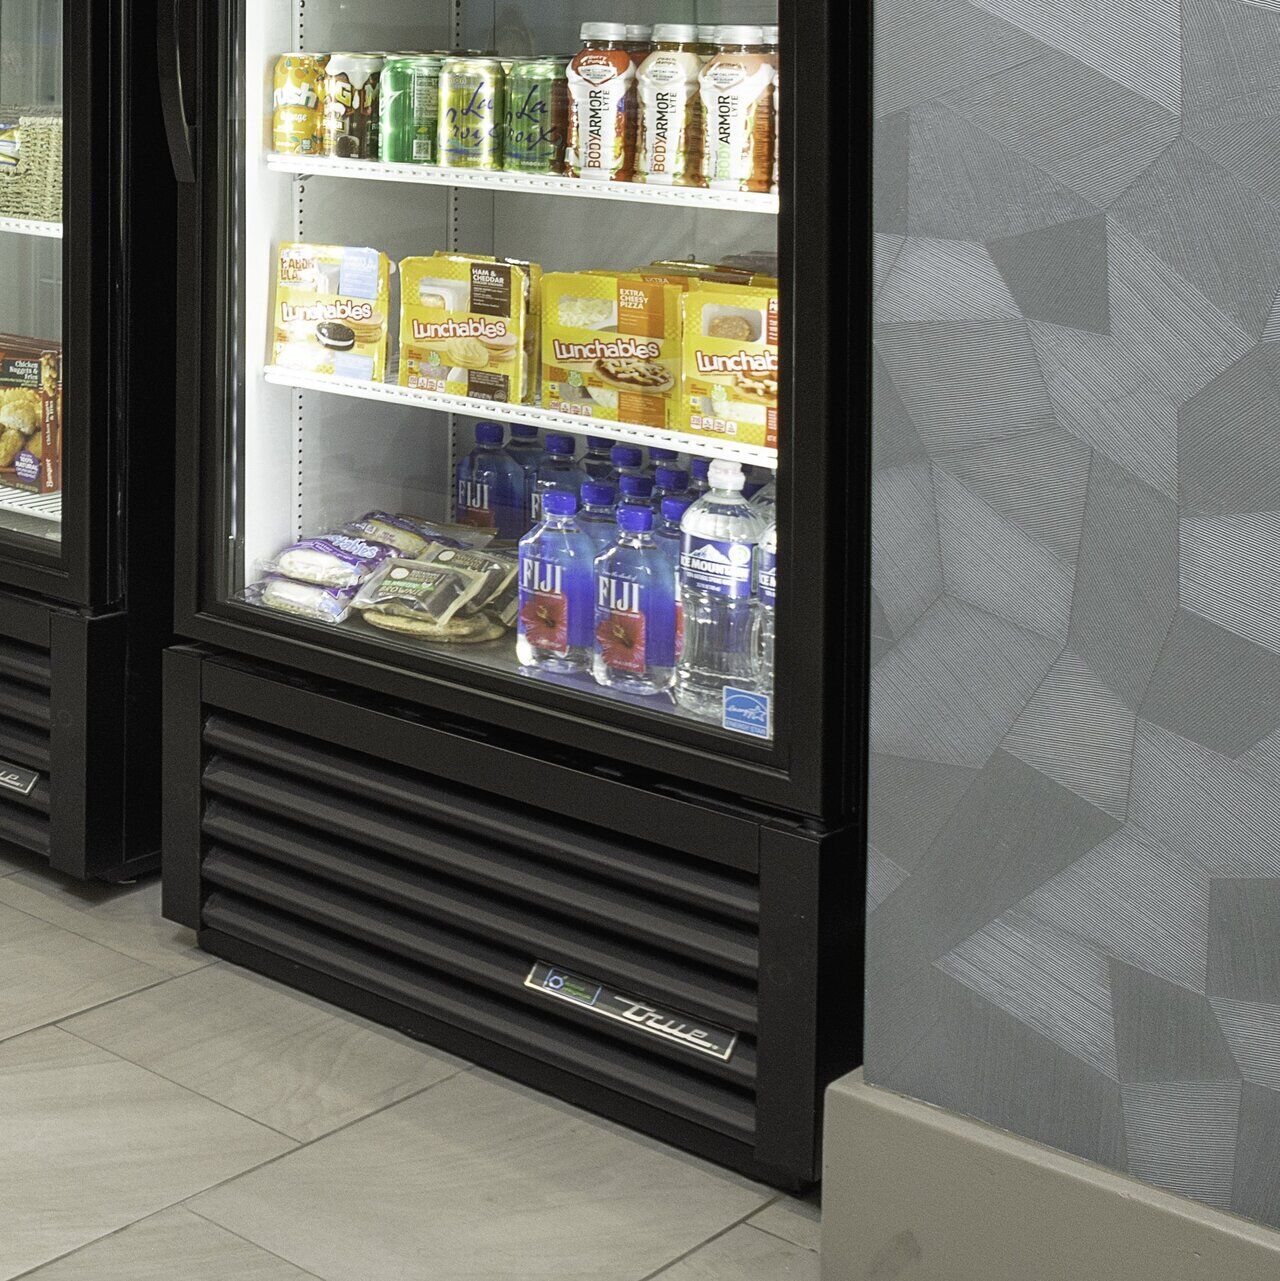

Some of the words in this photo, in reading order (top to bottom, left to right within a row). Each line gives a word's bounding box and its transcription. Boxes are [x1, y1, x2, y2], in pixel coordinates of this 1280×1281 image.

[669, 92, 678, 113] LYTE
[731, 95, 739, 117] LYTE
[619, 288, 645, 297] EXTRA
[619, 295, 649, 304] CHEESY
[281, 300, 372, 322] Lunchables
[620, 301, 644, 310] PIZZA
[412, 317, 507, 339] Lunchables
[553, 338, 660, 361] Lunchables
[696, 350, 778, 373] Lunchab
[458, 479, 490, 510] FIJI
[523, 557, 562, 594] FIJI
[599, 575, 639, 613] FIJI
